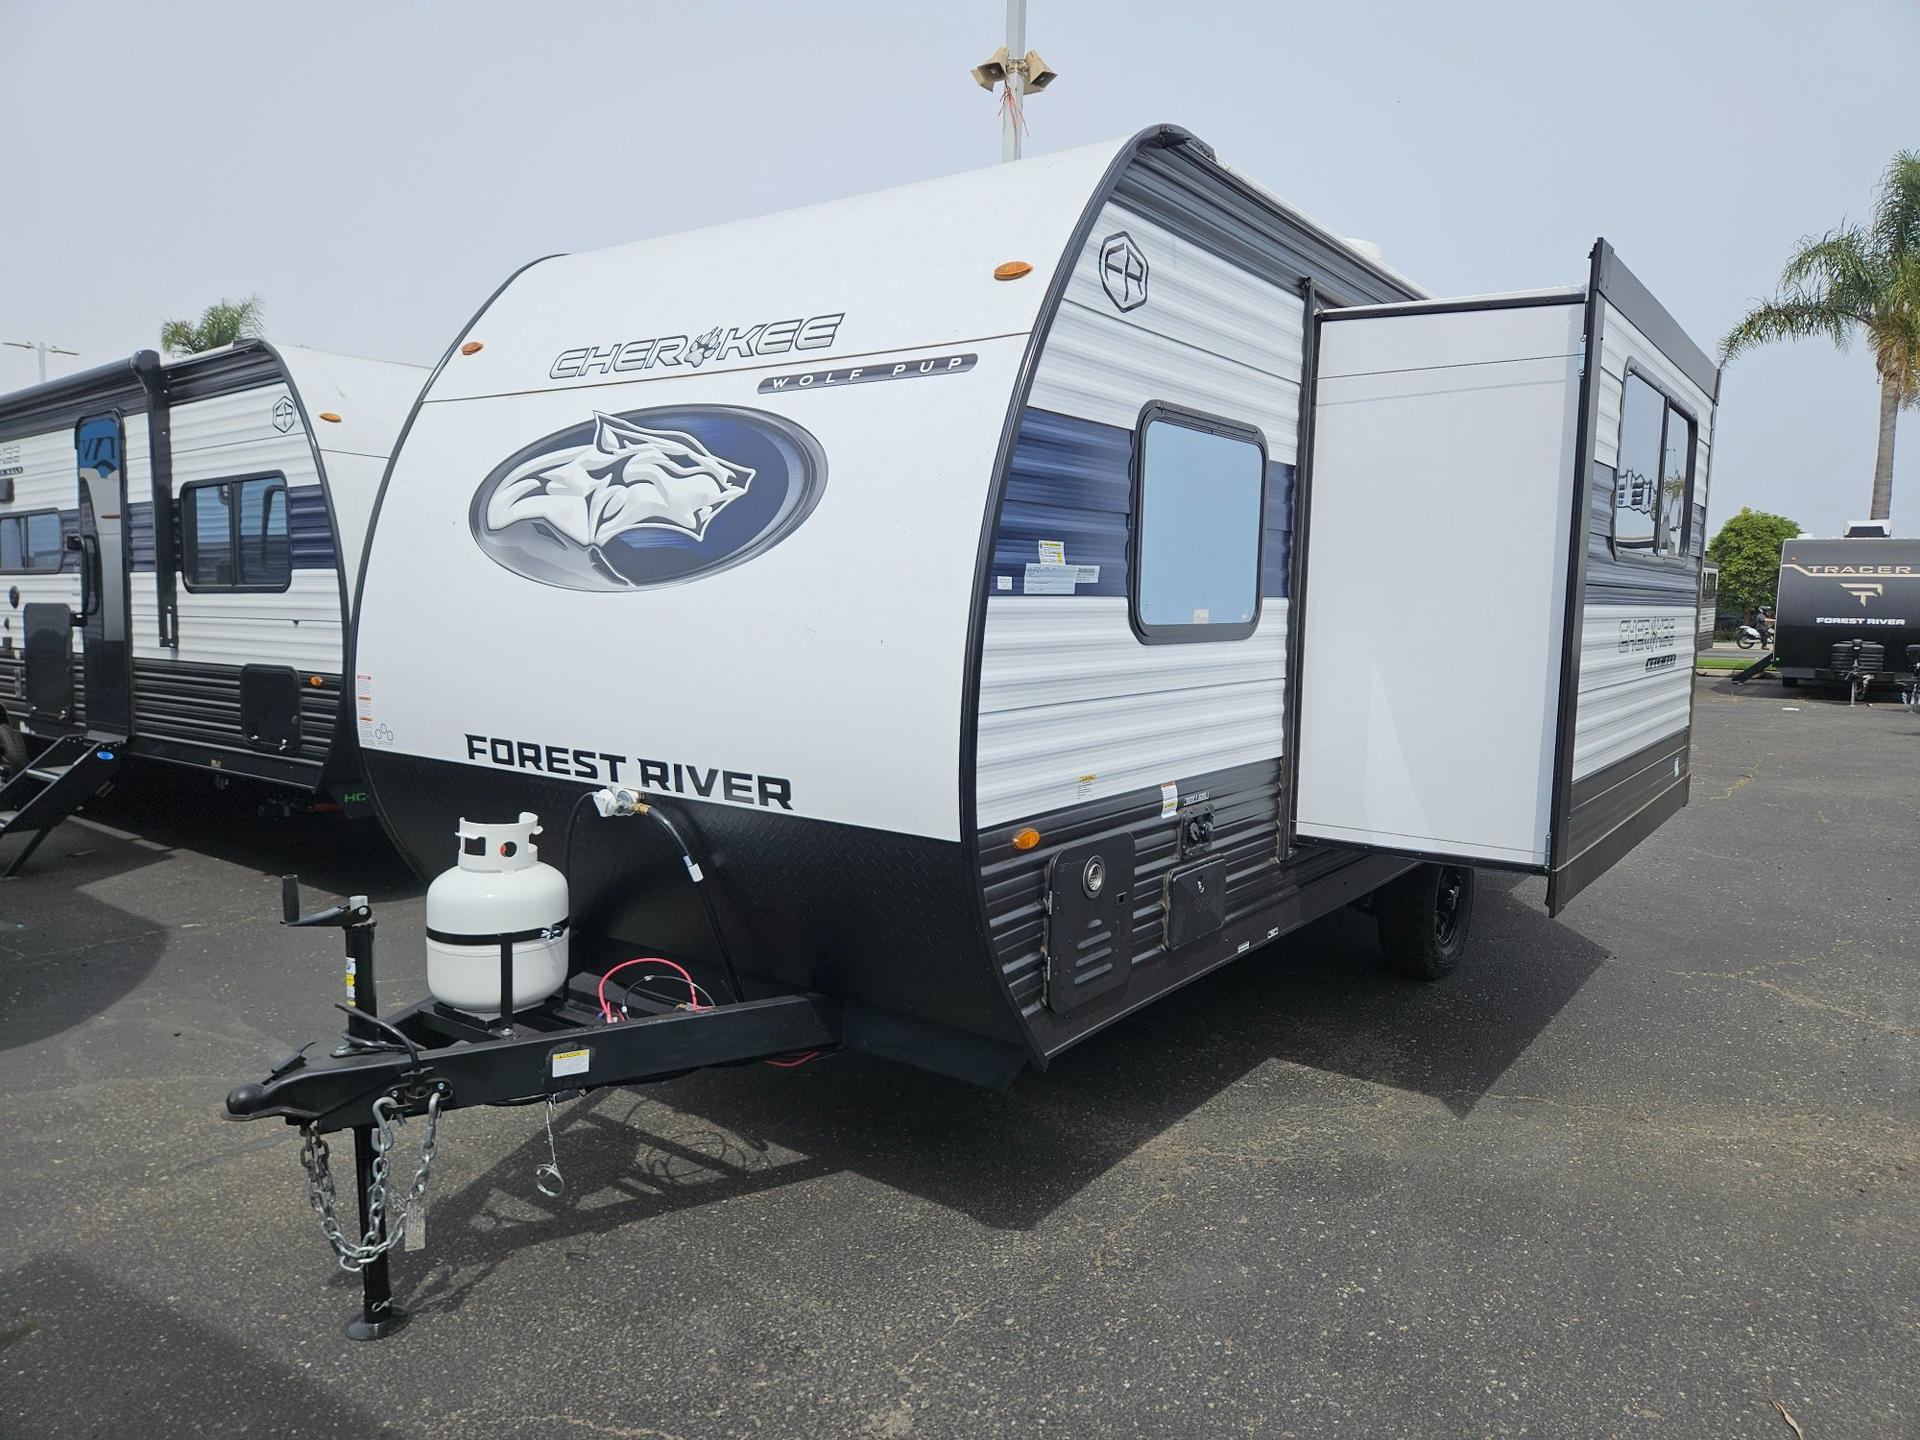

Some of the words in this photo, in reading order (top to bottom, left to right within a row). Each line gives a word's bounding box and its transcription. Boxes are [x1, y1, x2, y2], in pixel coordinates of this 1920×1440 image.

[549, 312, 846, 380] CHEROKEE
[772, 368, 863, 390] WOLF
[892, 357, 963, 376] PUP
[1807, 565, 1912, 574] TRACER
[1816, 617, 1865, 625] FOREST
[1867, 618, 1906, 626] RIVER
[464, 733, 627, 783] FOREST
[637, 758, 795, 811] RIVER
